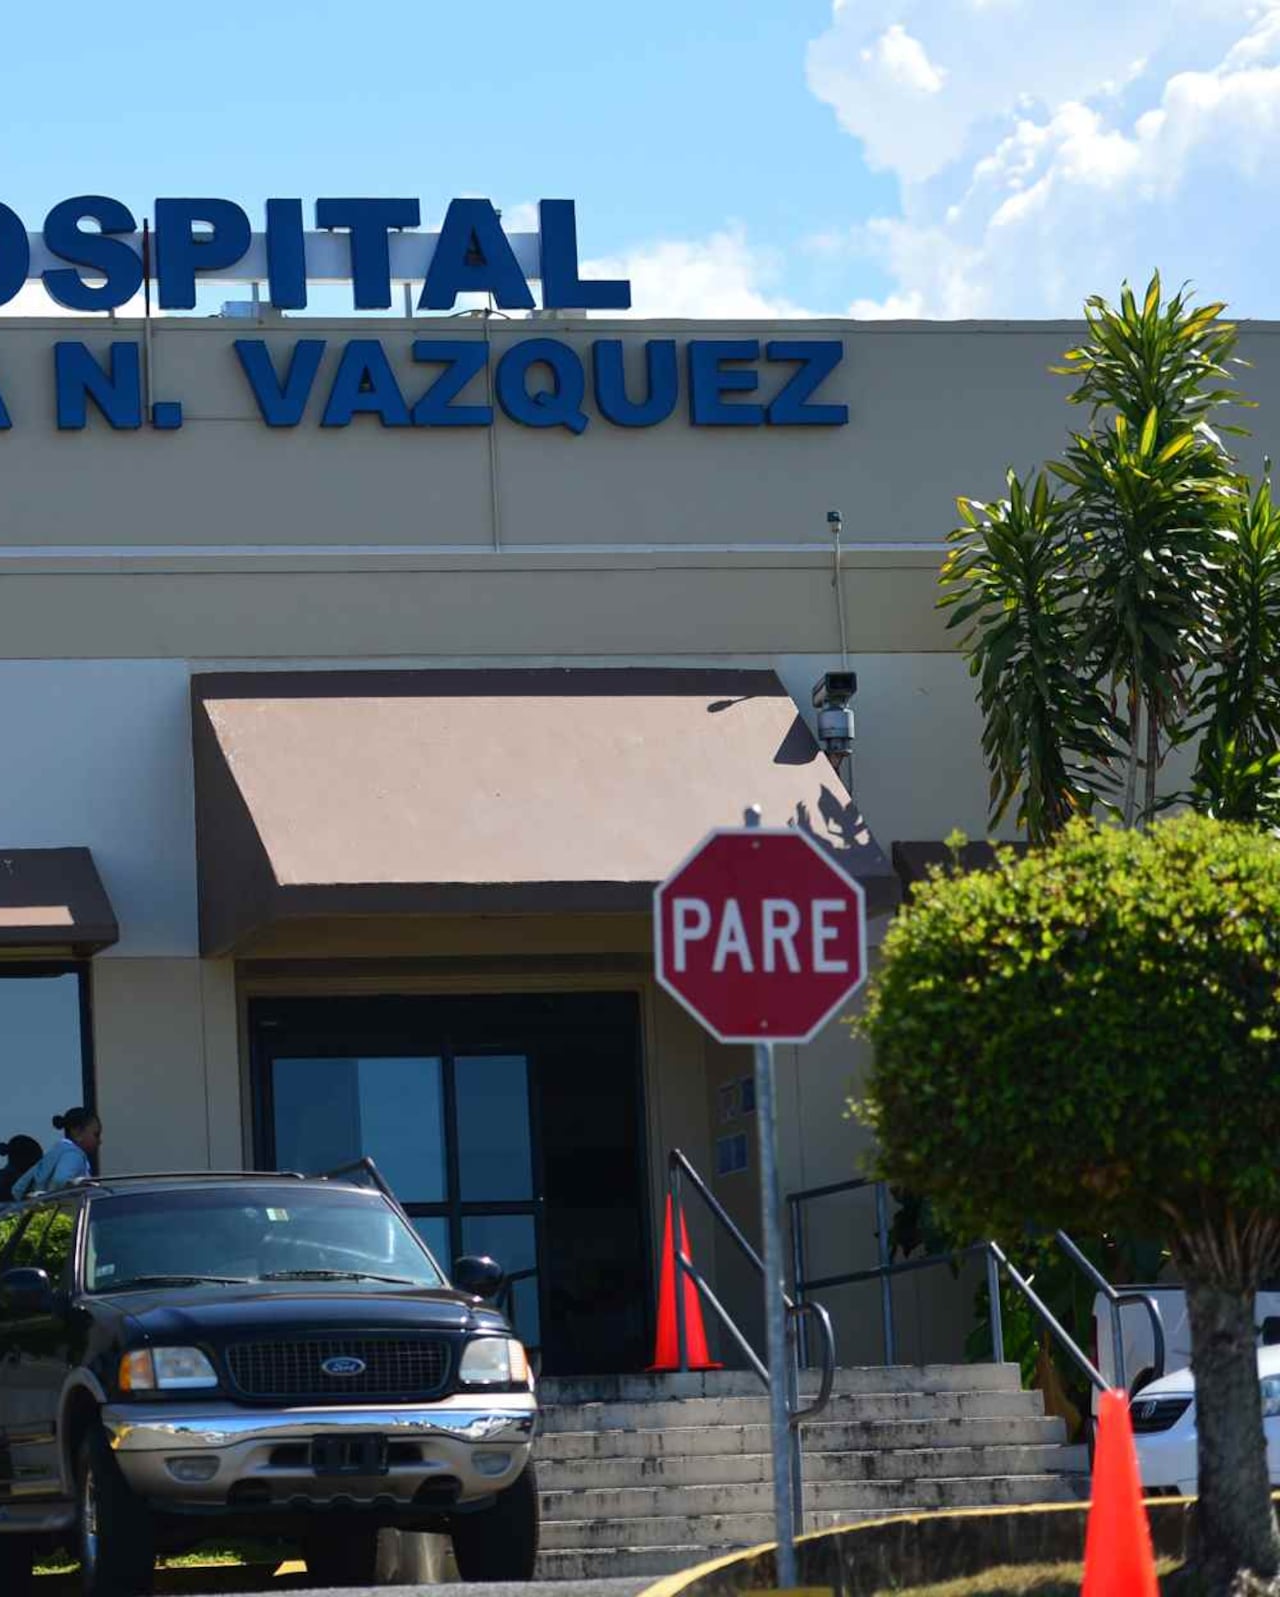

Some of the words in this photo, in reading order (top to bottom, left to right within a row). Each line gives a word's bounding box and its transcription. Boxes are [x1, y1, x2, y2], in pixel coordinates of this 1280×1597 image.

[54, 341, 183, 430] N.
[233, 338, 849, 435] VAZQUEZ
[672, 897, 849, 973] PARE
